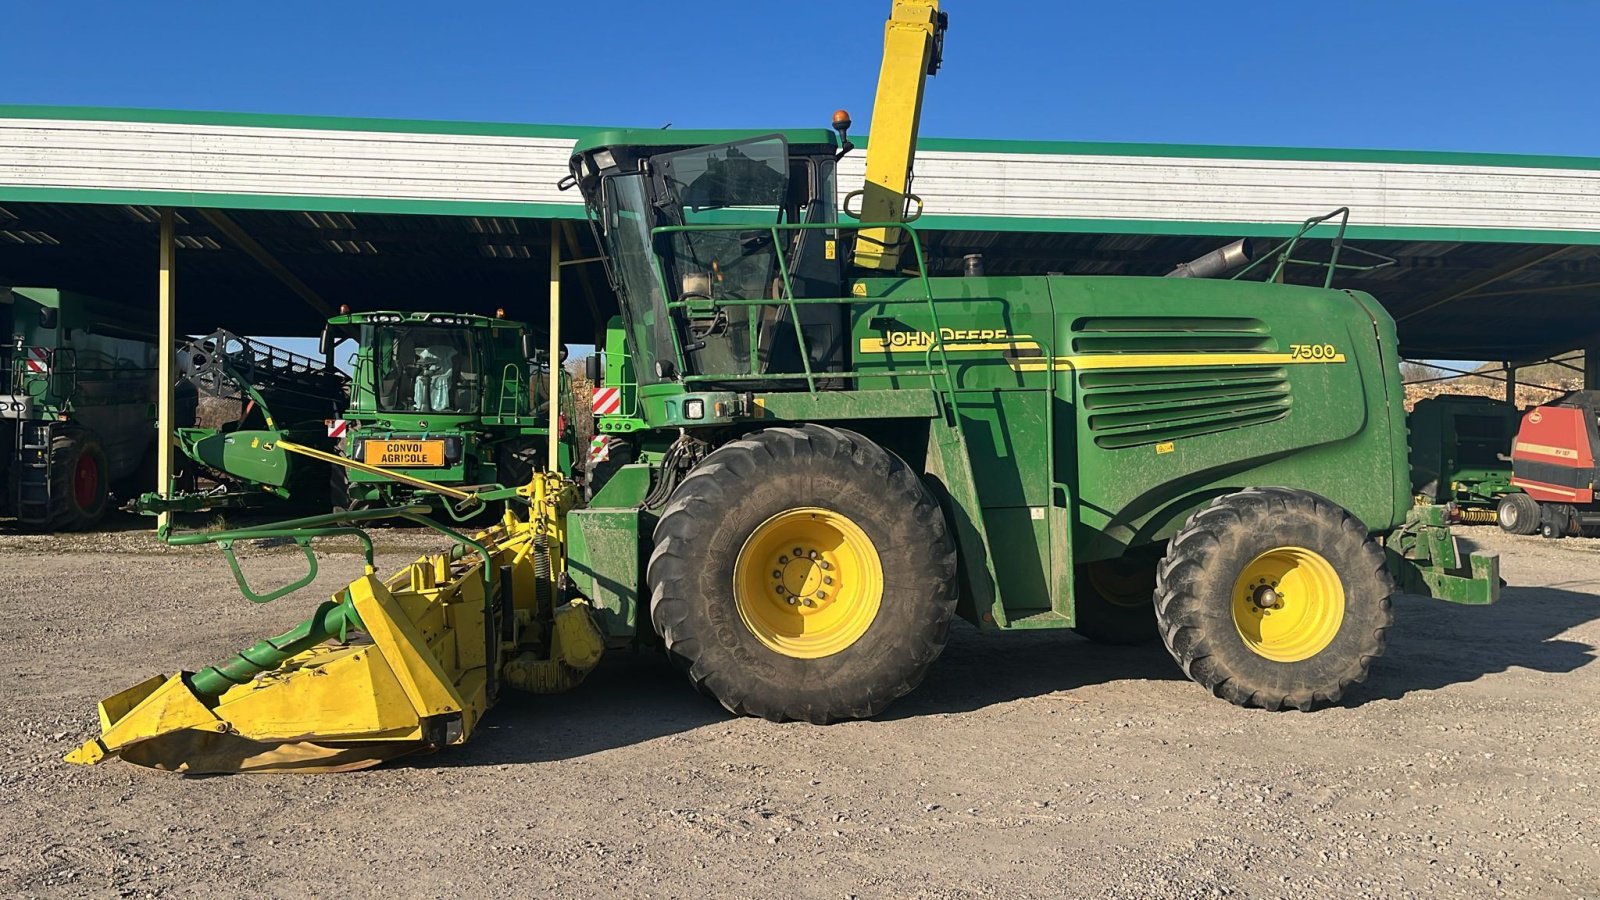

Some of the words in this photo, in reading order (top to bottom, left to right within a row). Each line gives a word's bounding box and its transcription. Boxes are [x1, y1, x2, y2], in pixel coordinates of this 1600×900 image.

[880, 329, 936, 346] JOHN
[1289, 343, 1336, 359] 7500
[387, 443, 422, 453] CONVOI
[381, 454, 428, 463] AGRICOLE
